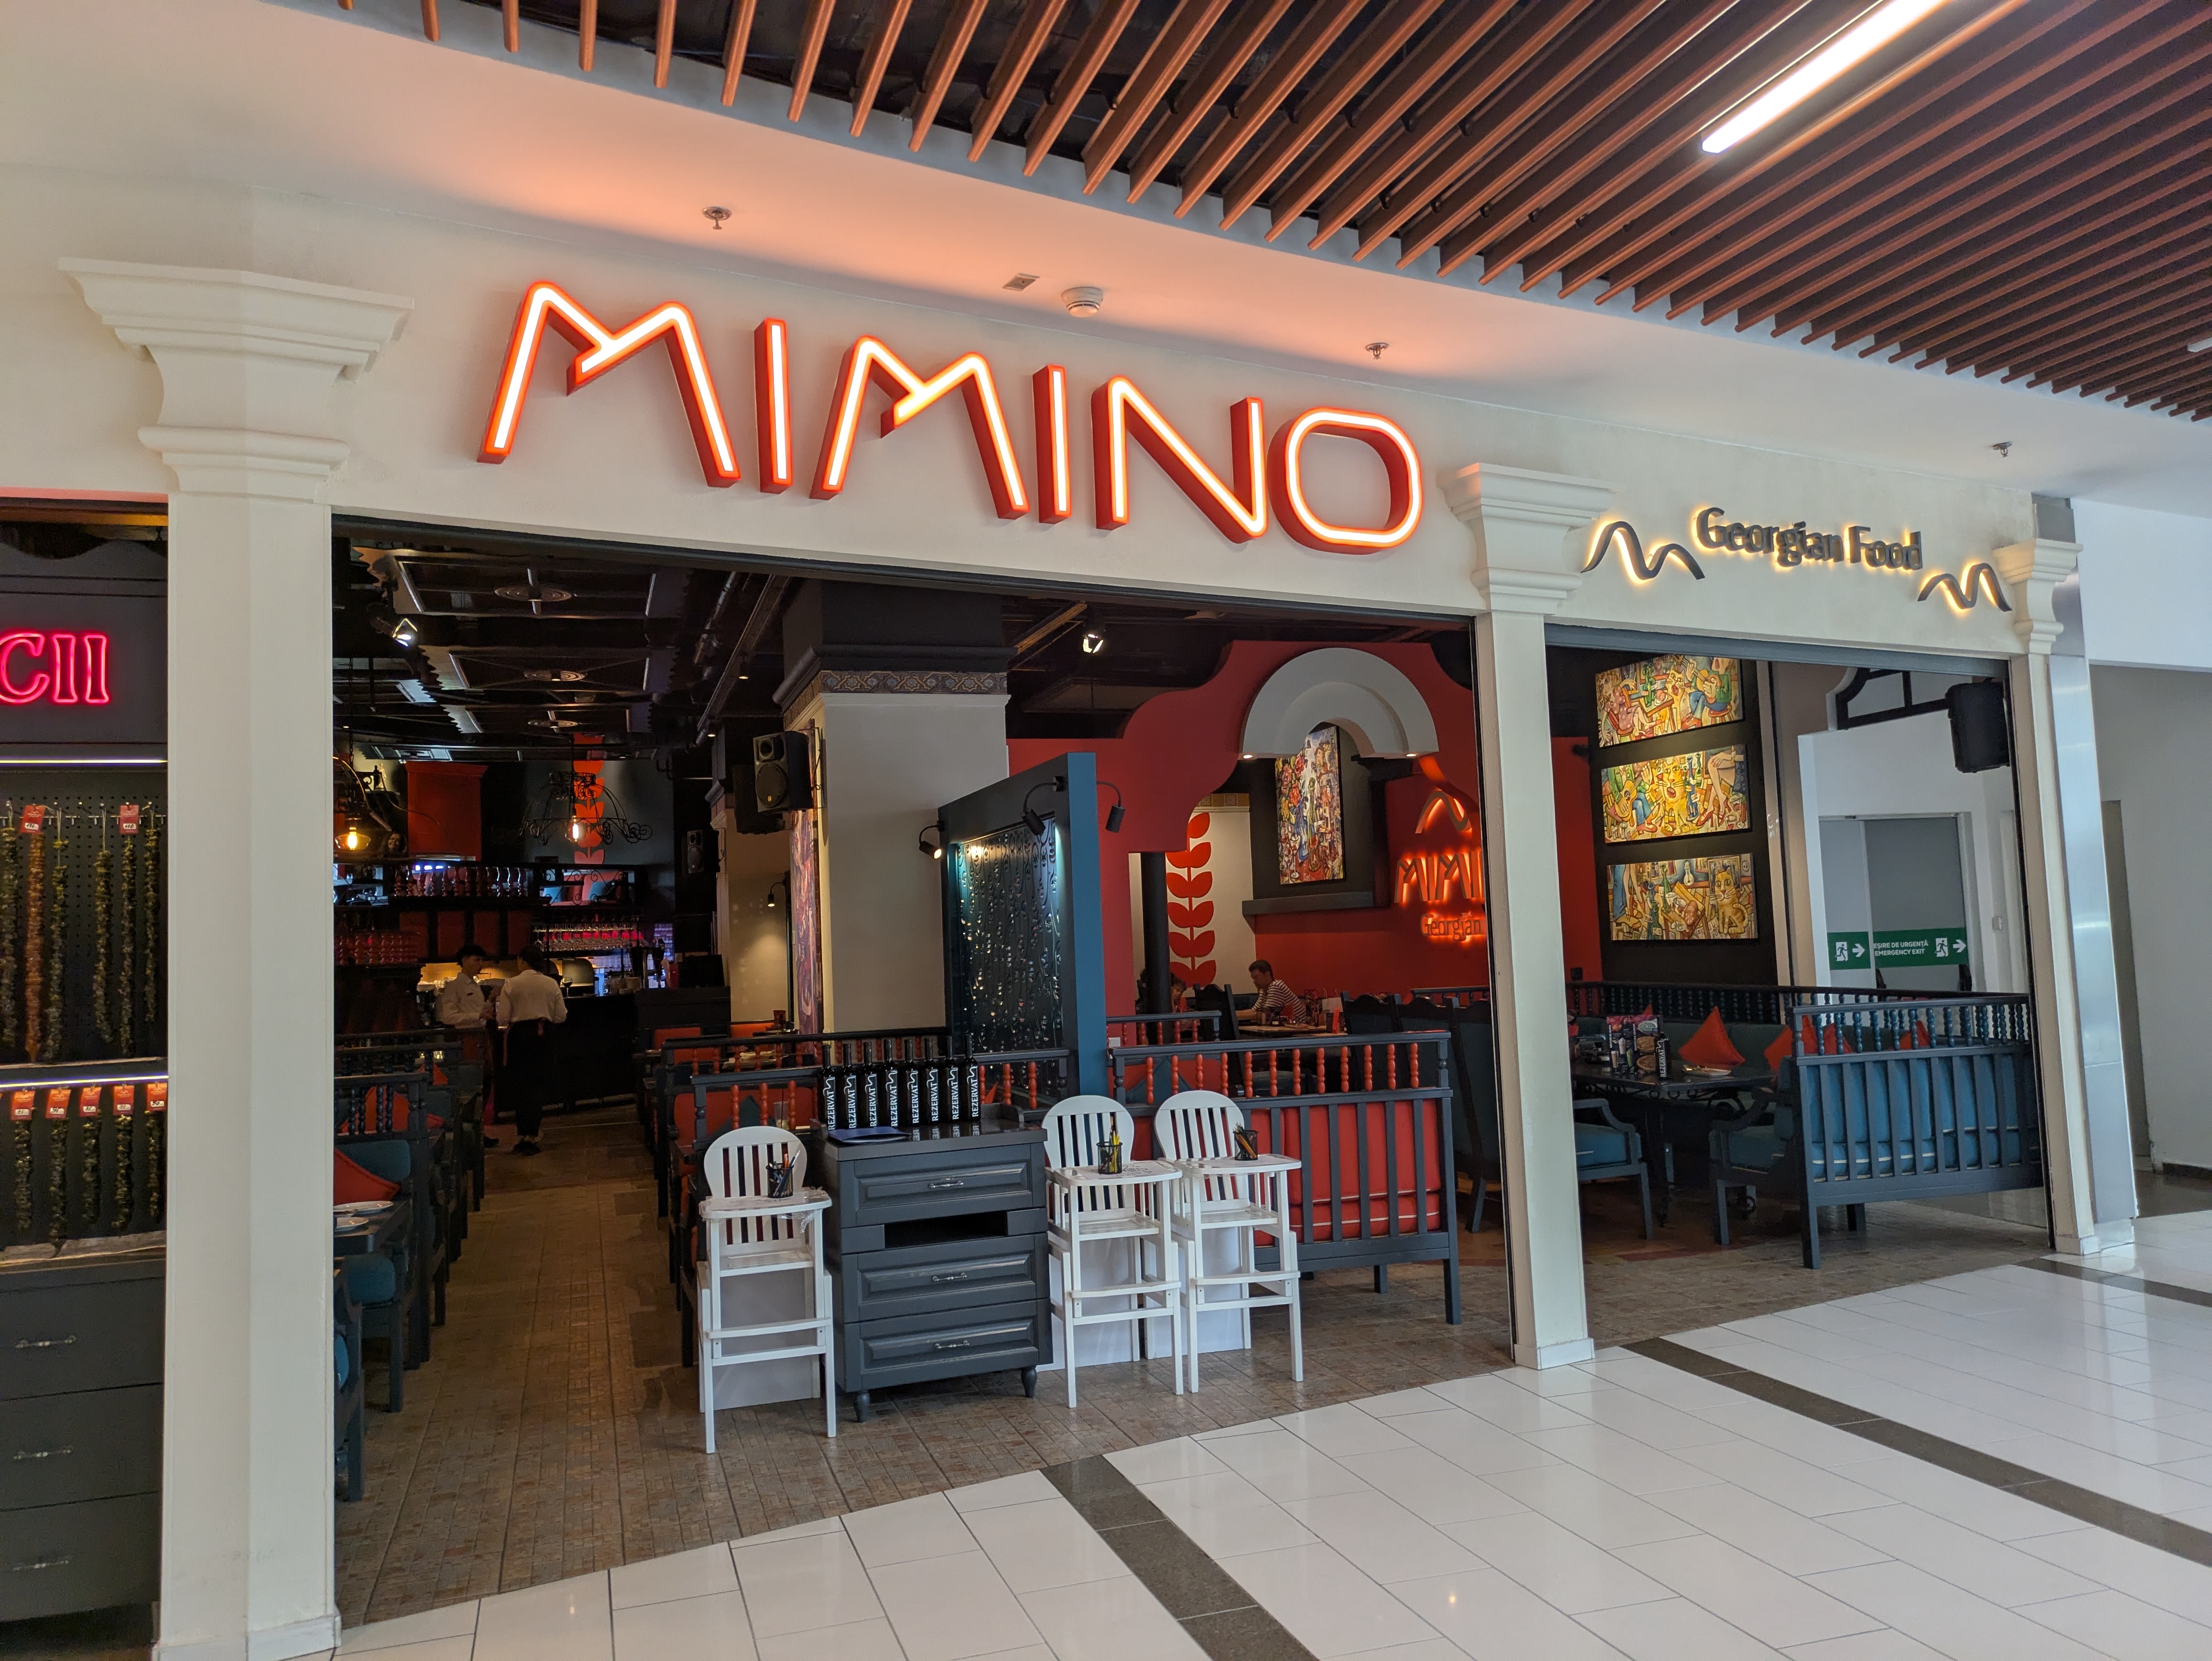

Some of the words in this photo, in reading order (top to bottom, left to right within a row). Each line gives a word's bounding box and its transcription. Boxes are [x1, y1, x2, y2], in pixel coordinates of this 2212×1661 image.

[477, 280, 1423, 554] MIMINO
[1695, 506, 1844, 567] Georgian
[1848, 525, 1923, 570] Food
[1394, 851, 1486, 903] MIMI
[1420, 911, 1486, 942] Georgian
[1900, 940, 1929, 948] URGENȚĂ
[1658, 1049, 1666, 1077] REZERVAT
[827, 1090, 836, 1130] REZERVAT
[848, 1089, 856, 1129] REZERVAT
[869, 1087, 877, 1127] REZERVAT
[890, 1085, 898, 1127] REZERVAT
